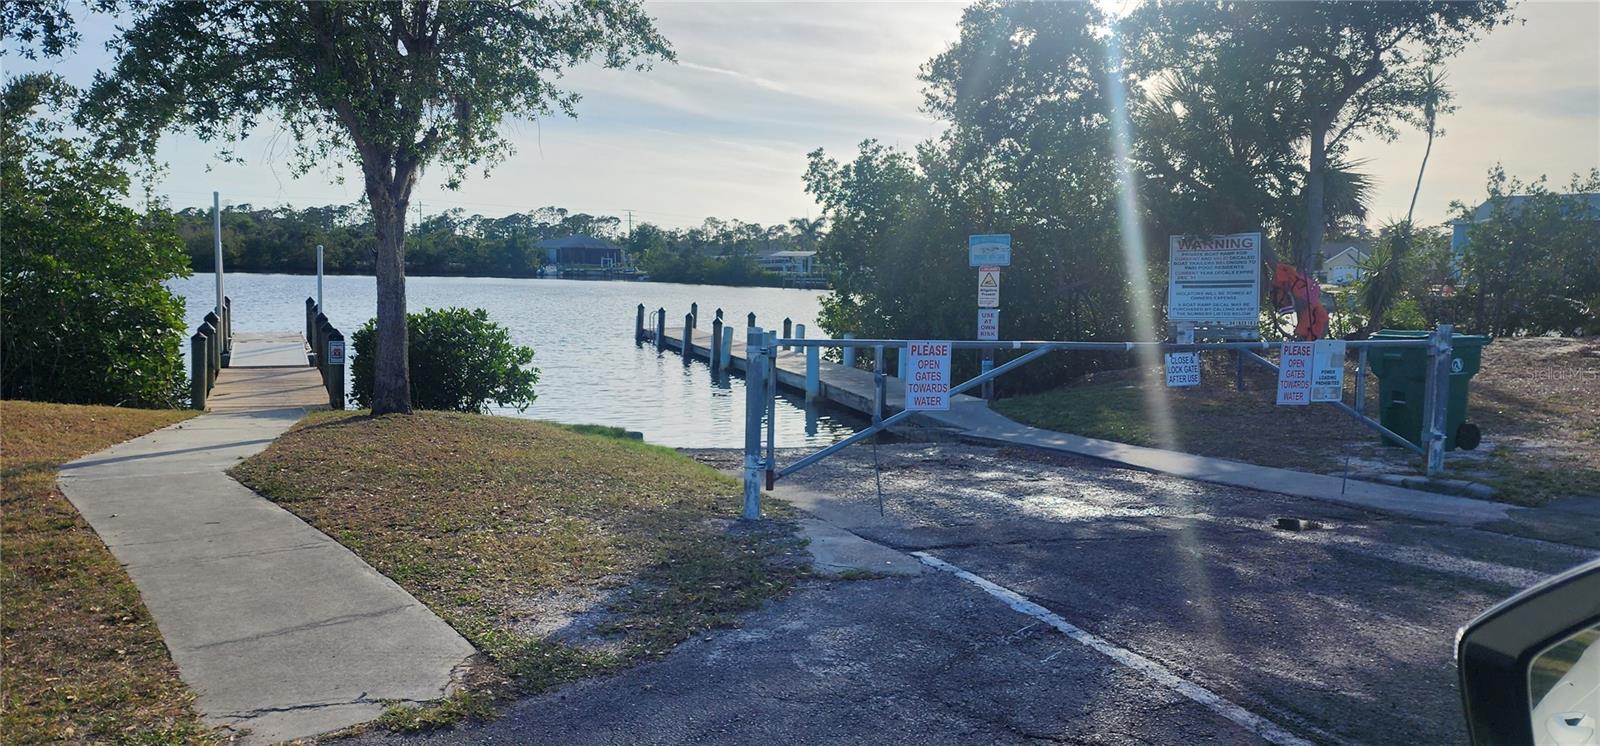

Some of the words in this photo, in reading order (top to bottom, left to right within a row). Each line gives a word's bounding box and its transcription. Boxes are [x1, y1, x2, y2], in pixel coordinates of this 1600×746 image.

[1178, 238, 1253, 250] WARNING
[911, 345, 947, 356] PLEASE
[1284, 346, 1311, 356] PLEASE
[918, 360, 940, 369] OPEN
[1288, 359, 1305, 368] OPEN
[1184, 365, 1198, 373] GATE
[915, 372, 941, 381] GATES
[1169, 375, 1186, 383] AFTER
[1188, 374, 1198, 383] USE
[1286, 370, 1305, 378] GATES
[909, 384, 948, 392] TOWARDS
[1280, 380, 1310, 389] TOWARDS
[1284, 392, 1304, 400] WATER
[914, 397, 941, 406] WATER
